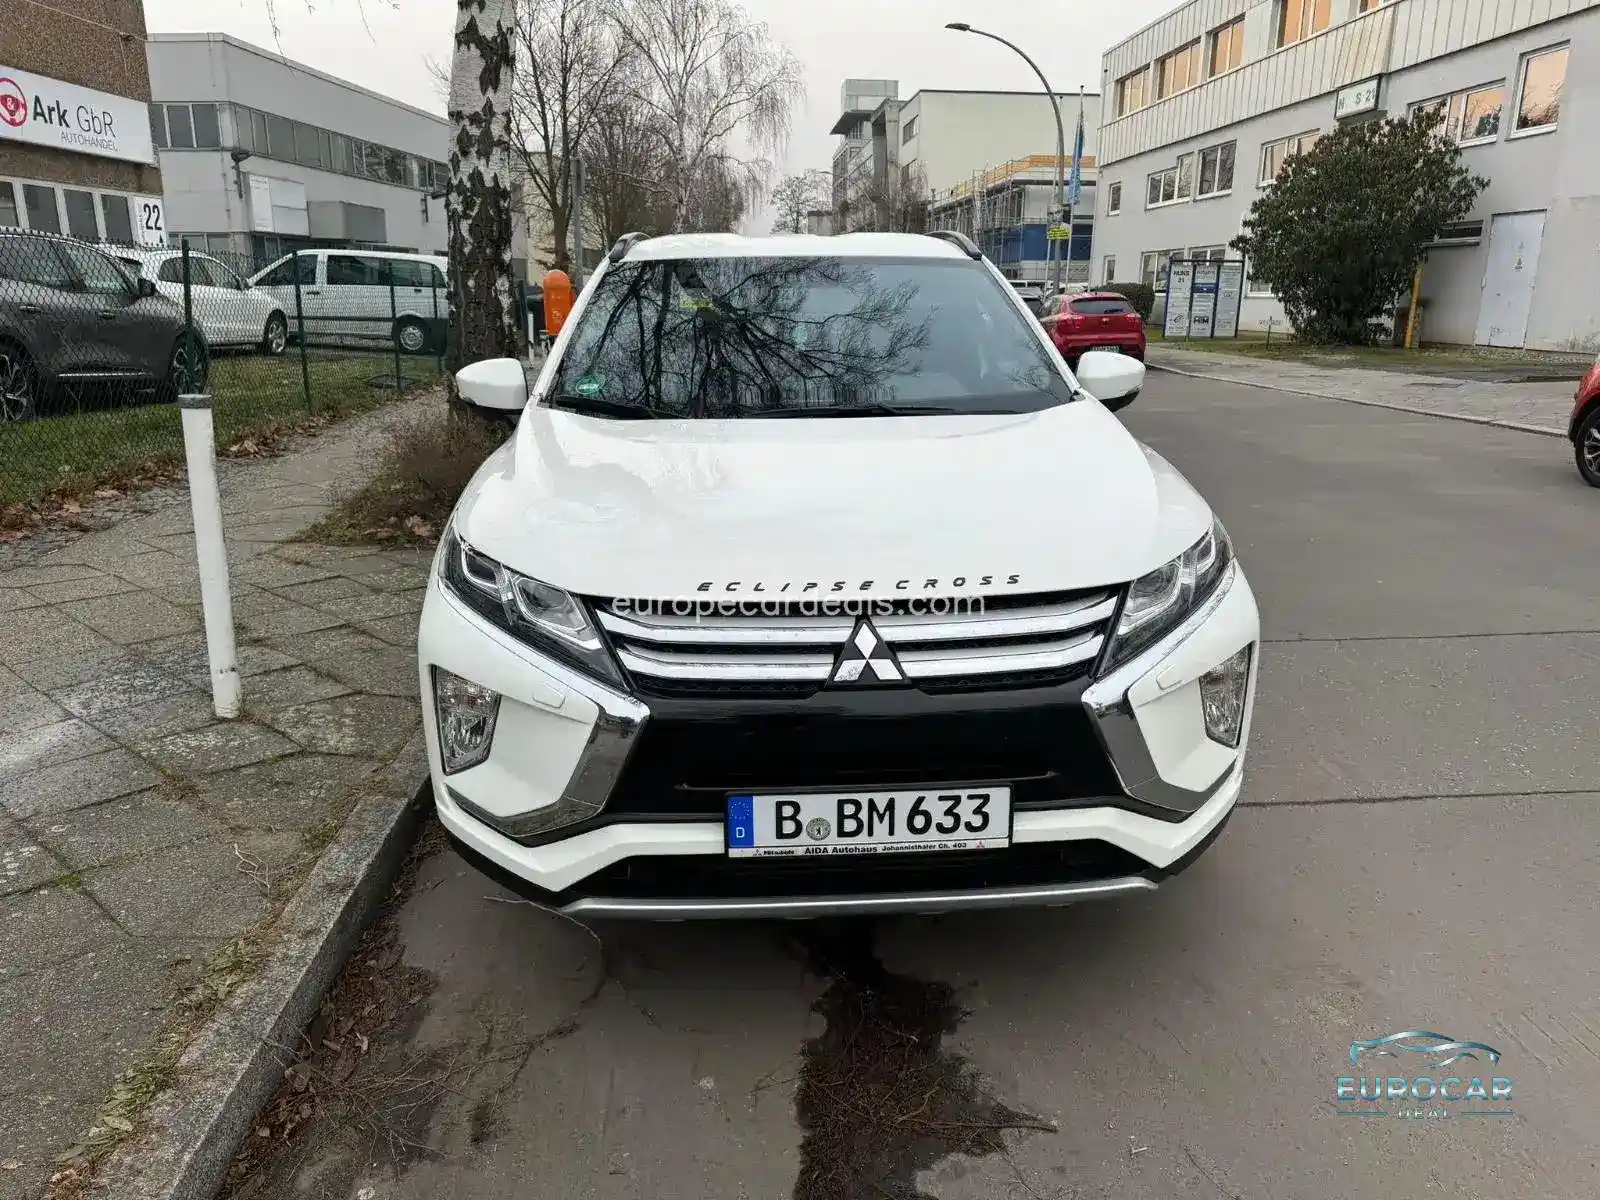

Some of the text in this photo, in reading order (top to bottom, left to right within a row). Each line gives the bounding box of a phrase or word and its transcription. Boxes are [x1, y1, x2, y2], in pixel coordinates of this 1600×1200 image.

[33, 95, 116, 137] Ark GbR
[61, 131, 118, 151] AUTOHANDEL
[143, 203, 162, 231] 22
[697, 575, 1020, 592] ECLIPSE CROSS
[735, 793, 991, 840] D B BM 633
[804, 846, 829, 855] AIDA
[831, 845, 878, 855] Autohaus
[881, 844, 936, 852] Johannisthaler
